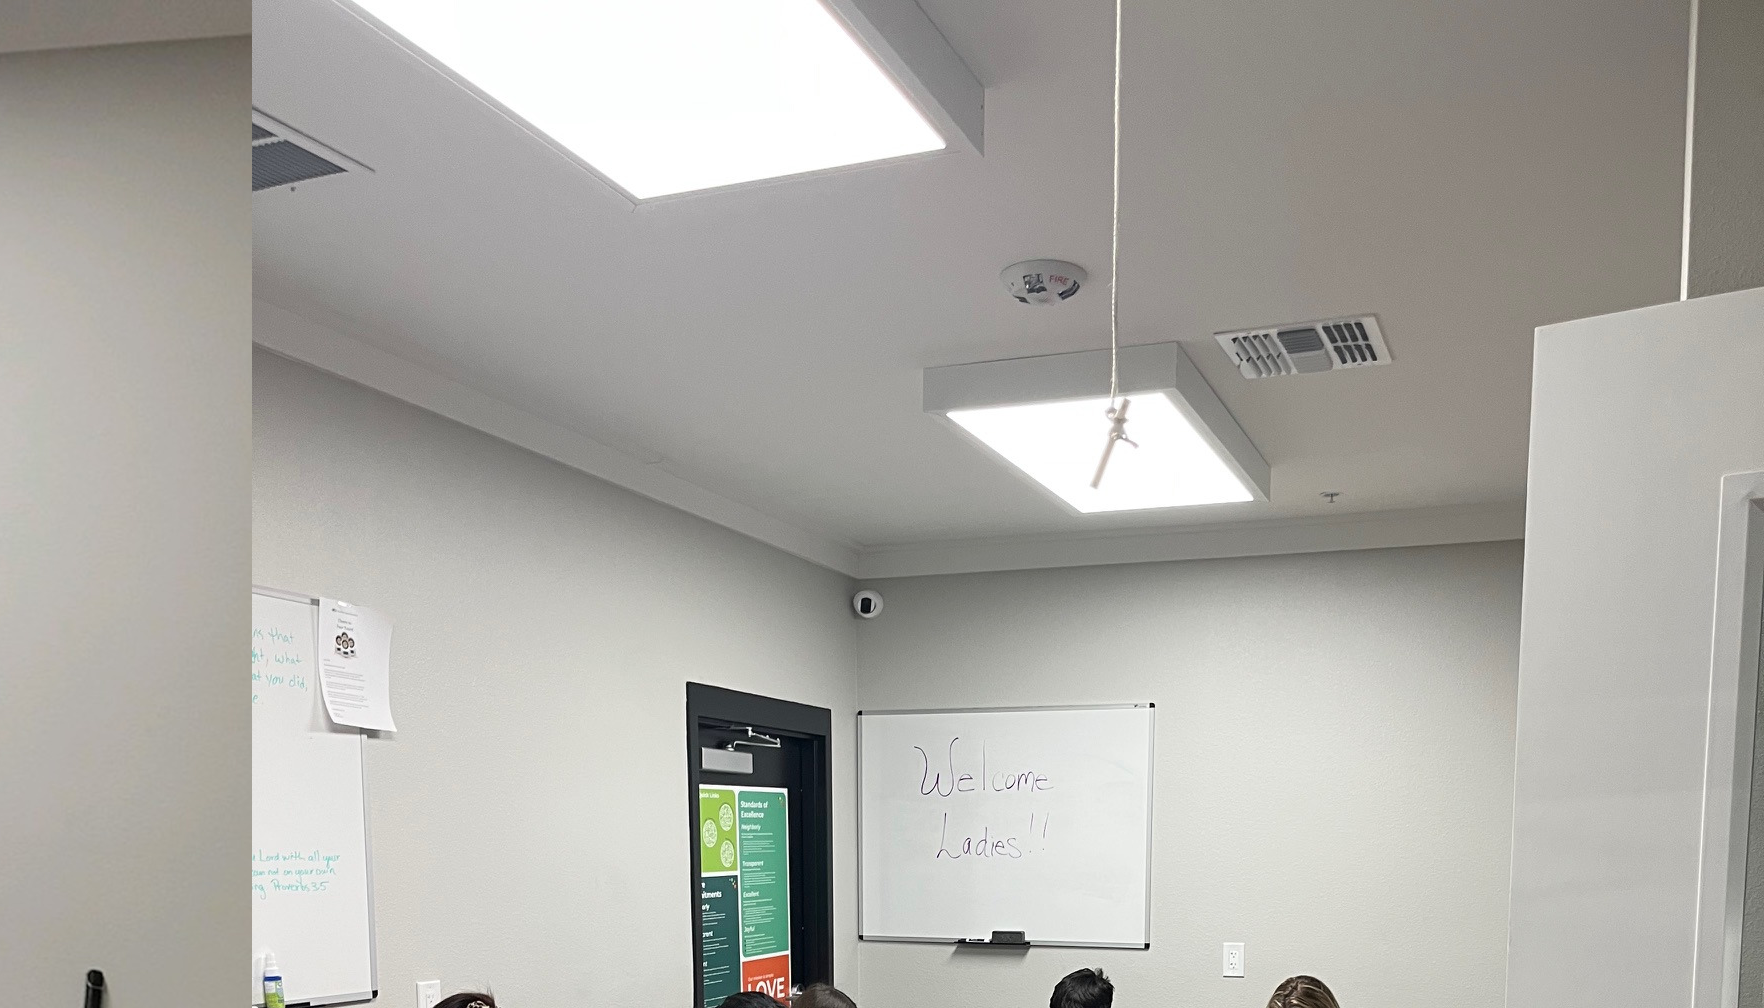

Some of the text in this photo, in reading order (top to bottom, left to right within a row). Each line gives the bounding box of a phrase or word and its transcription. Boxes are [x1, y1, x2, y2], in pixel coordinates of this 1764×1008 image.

[1049, 275, 1070, 286] FIRE
[914, 737, 1054, 798] Welcome
[740, 800, 763, 808] Standards
[740, 811, 764, 819] Excellence
[741, 824, 762, 832] Neighborly
[935, 812, 1049, 860] Ladies!!
[742, 860, 764, 868] Transparent
[743, 891, 759, 899] Excellent
